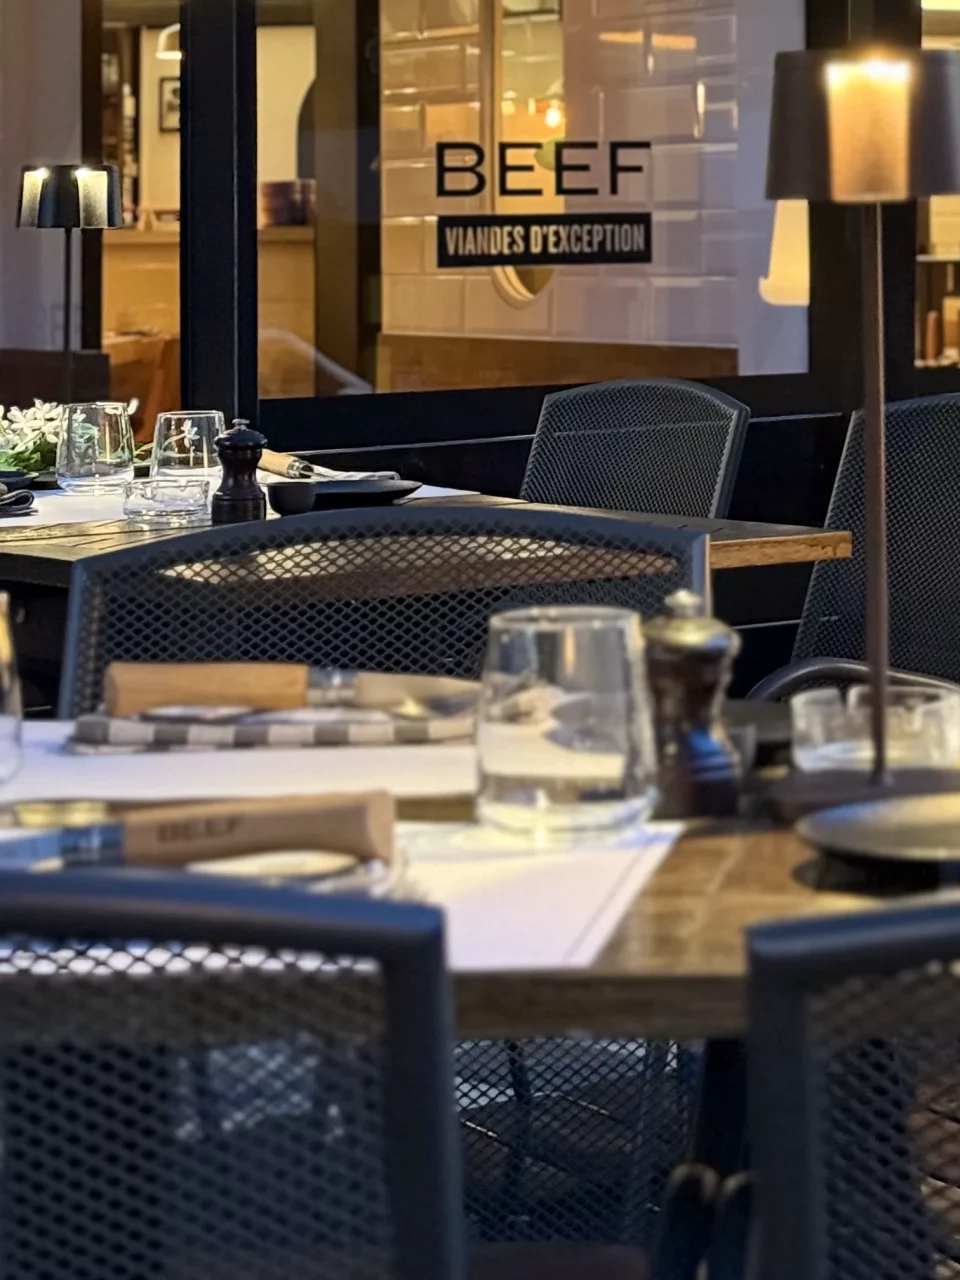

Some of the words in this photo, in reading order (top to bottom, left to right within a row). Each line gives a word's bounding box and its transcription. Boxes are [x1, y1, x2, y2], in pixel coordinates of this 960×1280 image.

[436, 141, 652, 197] BEEF
[445, 225, 525, 256] VIANDES
[529, 223, 645, 255] D'EXCEPTION
